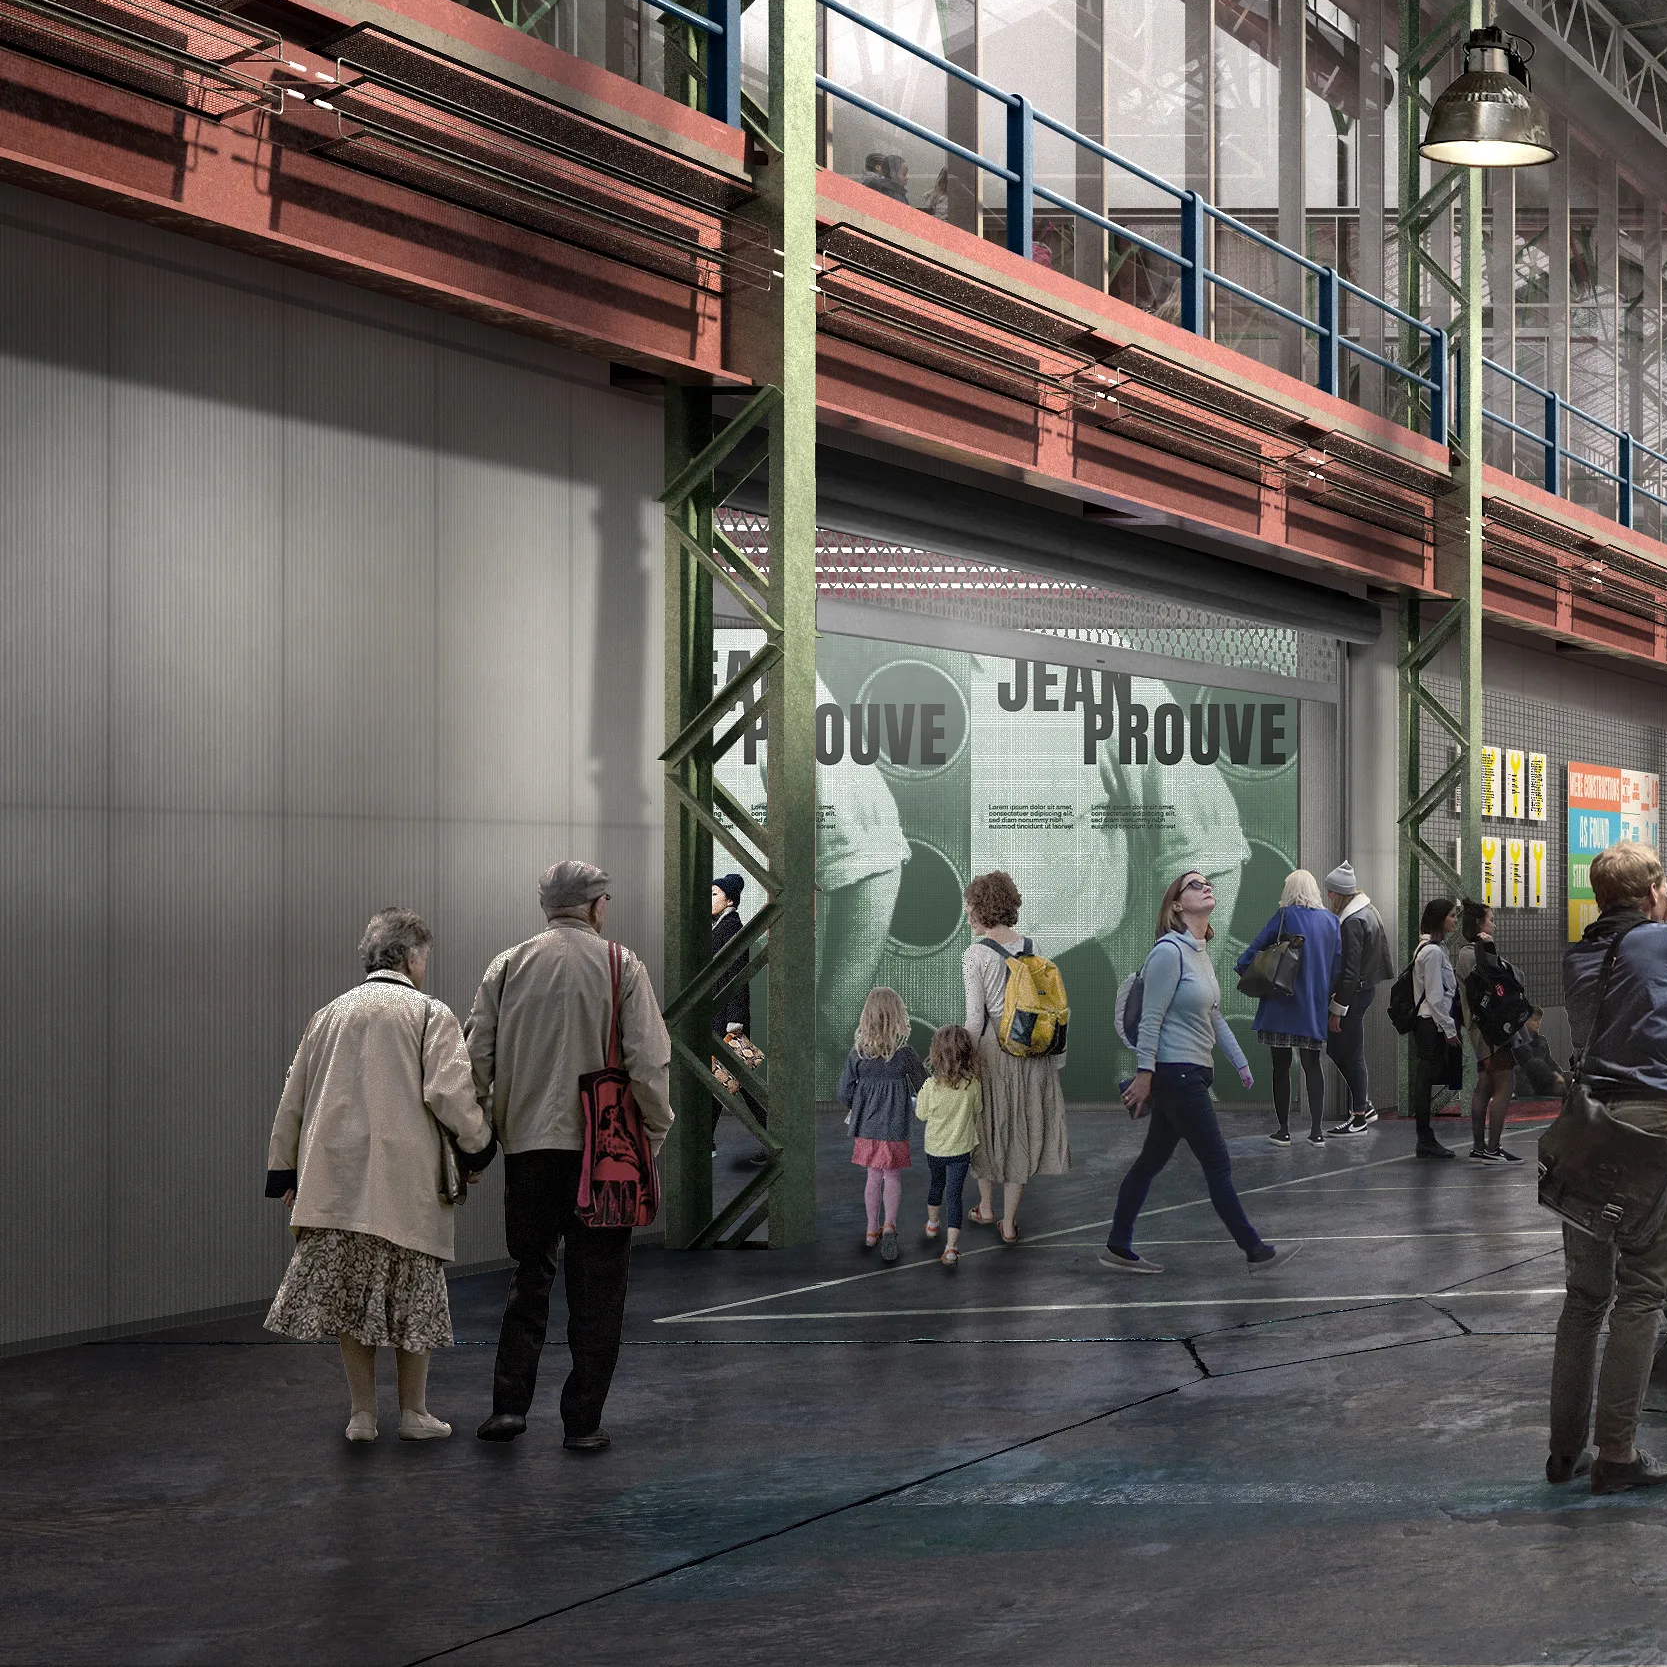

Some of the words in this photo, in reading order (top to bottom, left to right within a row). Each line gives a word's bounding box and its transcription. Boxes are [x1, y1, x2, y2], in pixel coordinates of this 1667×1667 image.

[998, 660, 1132, 712] JEAN
[744, 703, 946, 766] POUVE
[1083, 702, 1287, 766] PROUVE
[1579, 815, 1588, 849] AS
[1589, 816, 1610, 850] FOUND
